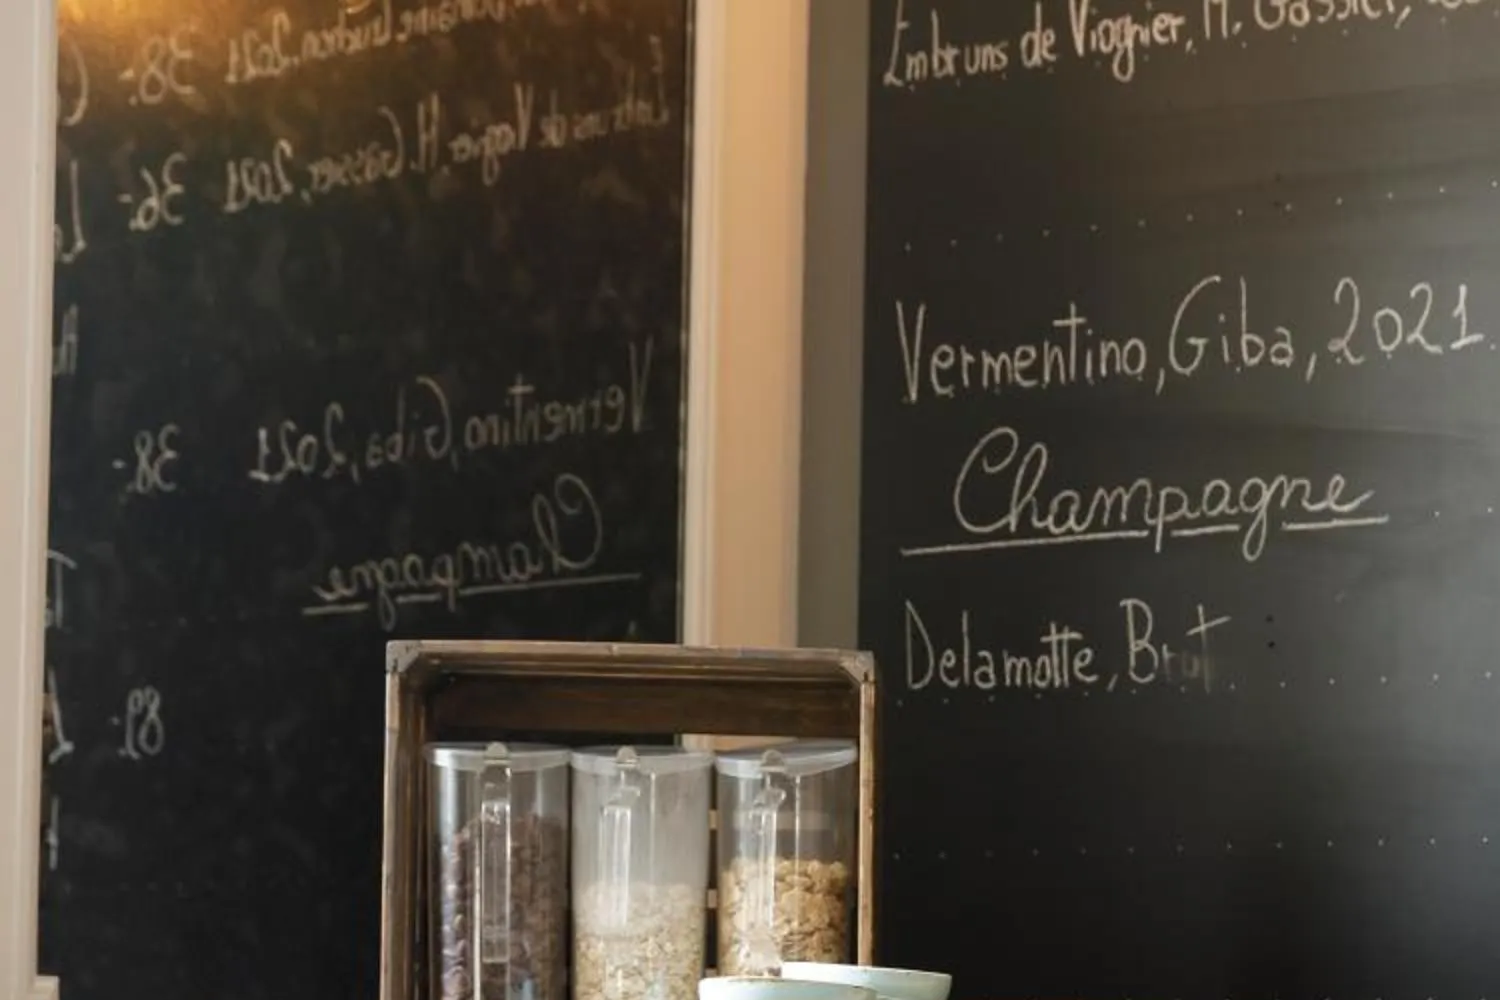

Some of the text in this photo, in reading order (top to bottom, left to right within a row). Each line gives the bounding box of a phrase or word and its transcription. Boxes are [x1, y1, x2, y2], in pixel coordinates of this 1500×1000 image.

[882, 0, 1009, 87] Embruns
[1020, 1, 1058, 68] de
[1067, 0, 1193, 83] Viognier,
[894, 299, 1168, 404] Vermentino,
[1166, 275, 1318, 384] Giba,
[1327, 276, 1485, 365] 2021
[952, 426, 1376, 561] Champagne
[903, 598, 1118, 693] Delamotte,
